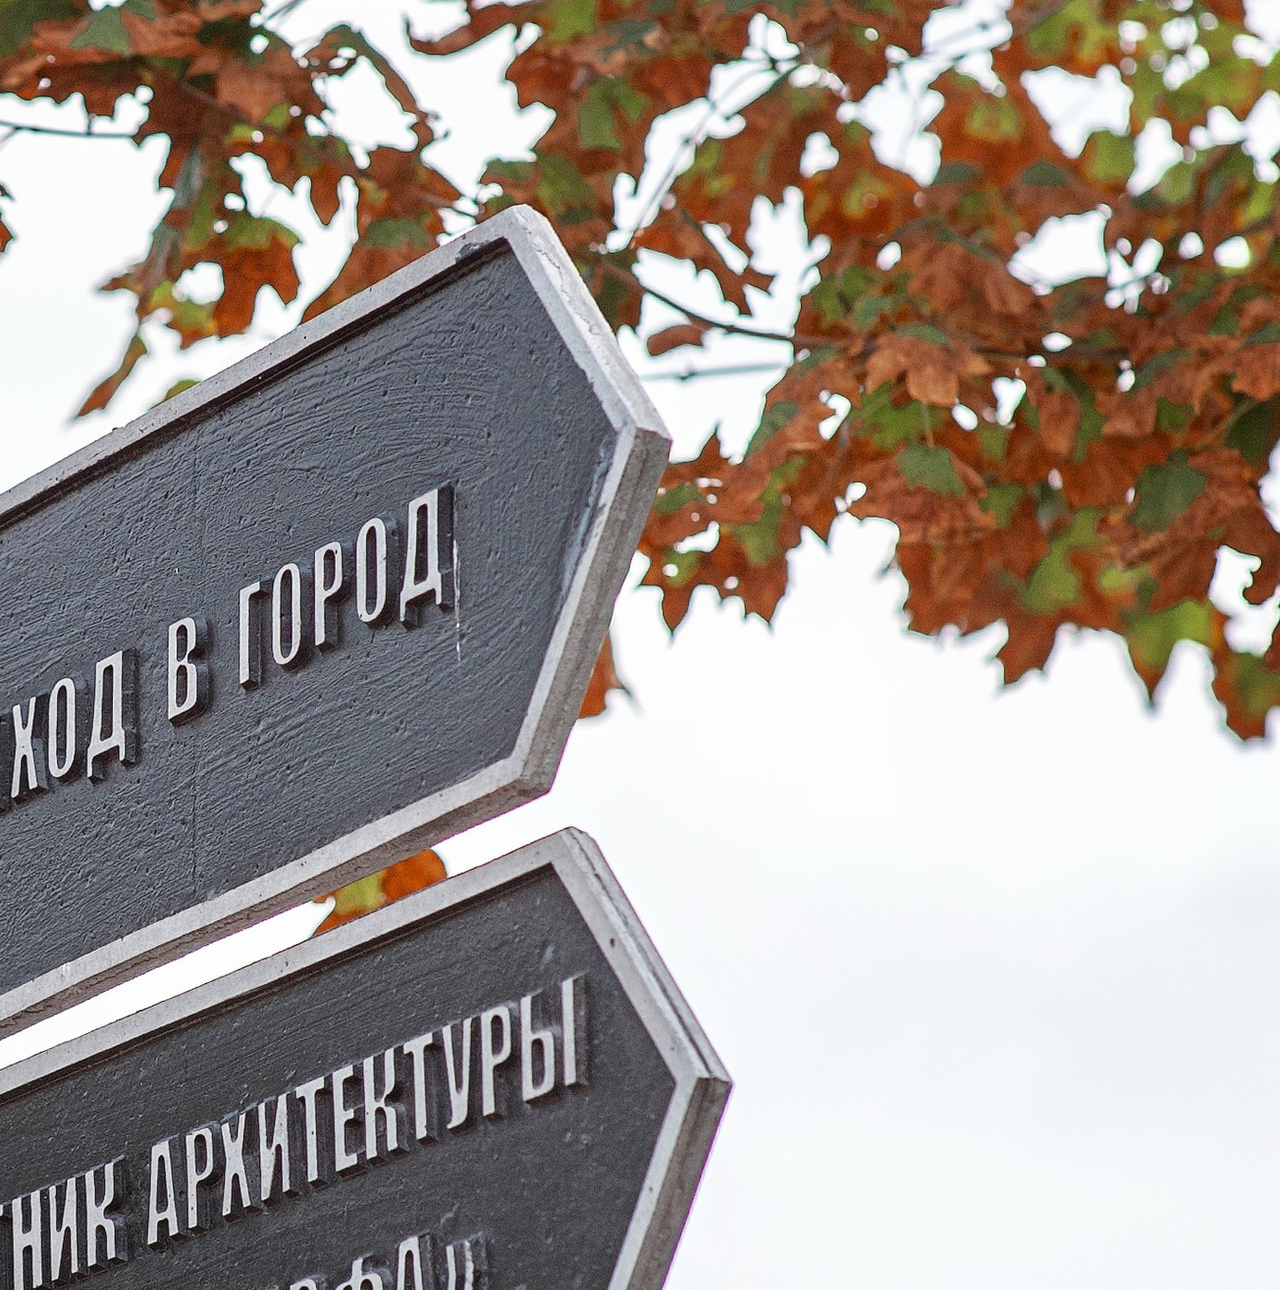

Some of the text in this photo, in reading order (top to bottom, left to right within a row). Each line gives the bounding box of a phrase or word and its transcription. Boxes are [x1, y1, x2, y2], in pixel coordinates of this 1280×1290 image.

[167, 617, 209, 724] В
[239, 485, 452, 689] ГОРОД
[147, 975, 586, 1247] АРХИТЕКТУРЫ
